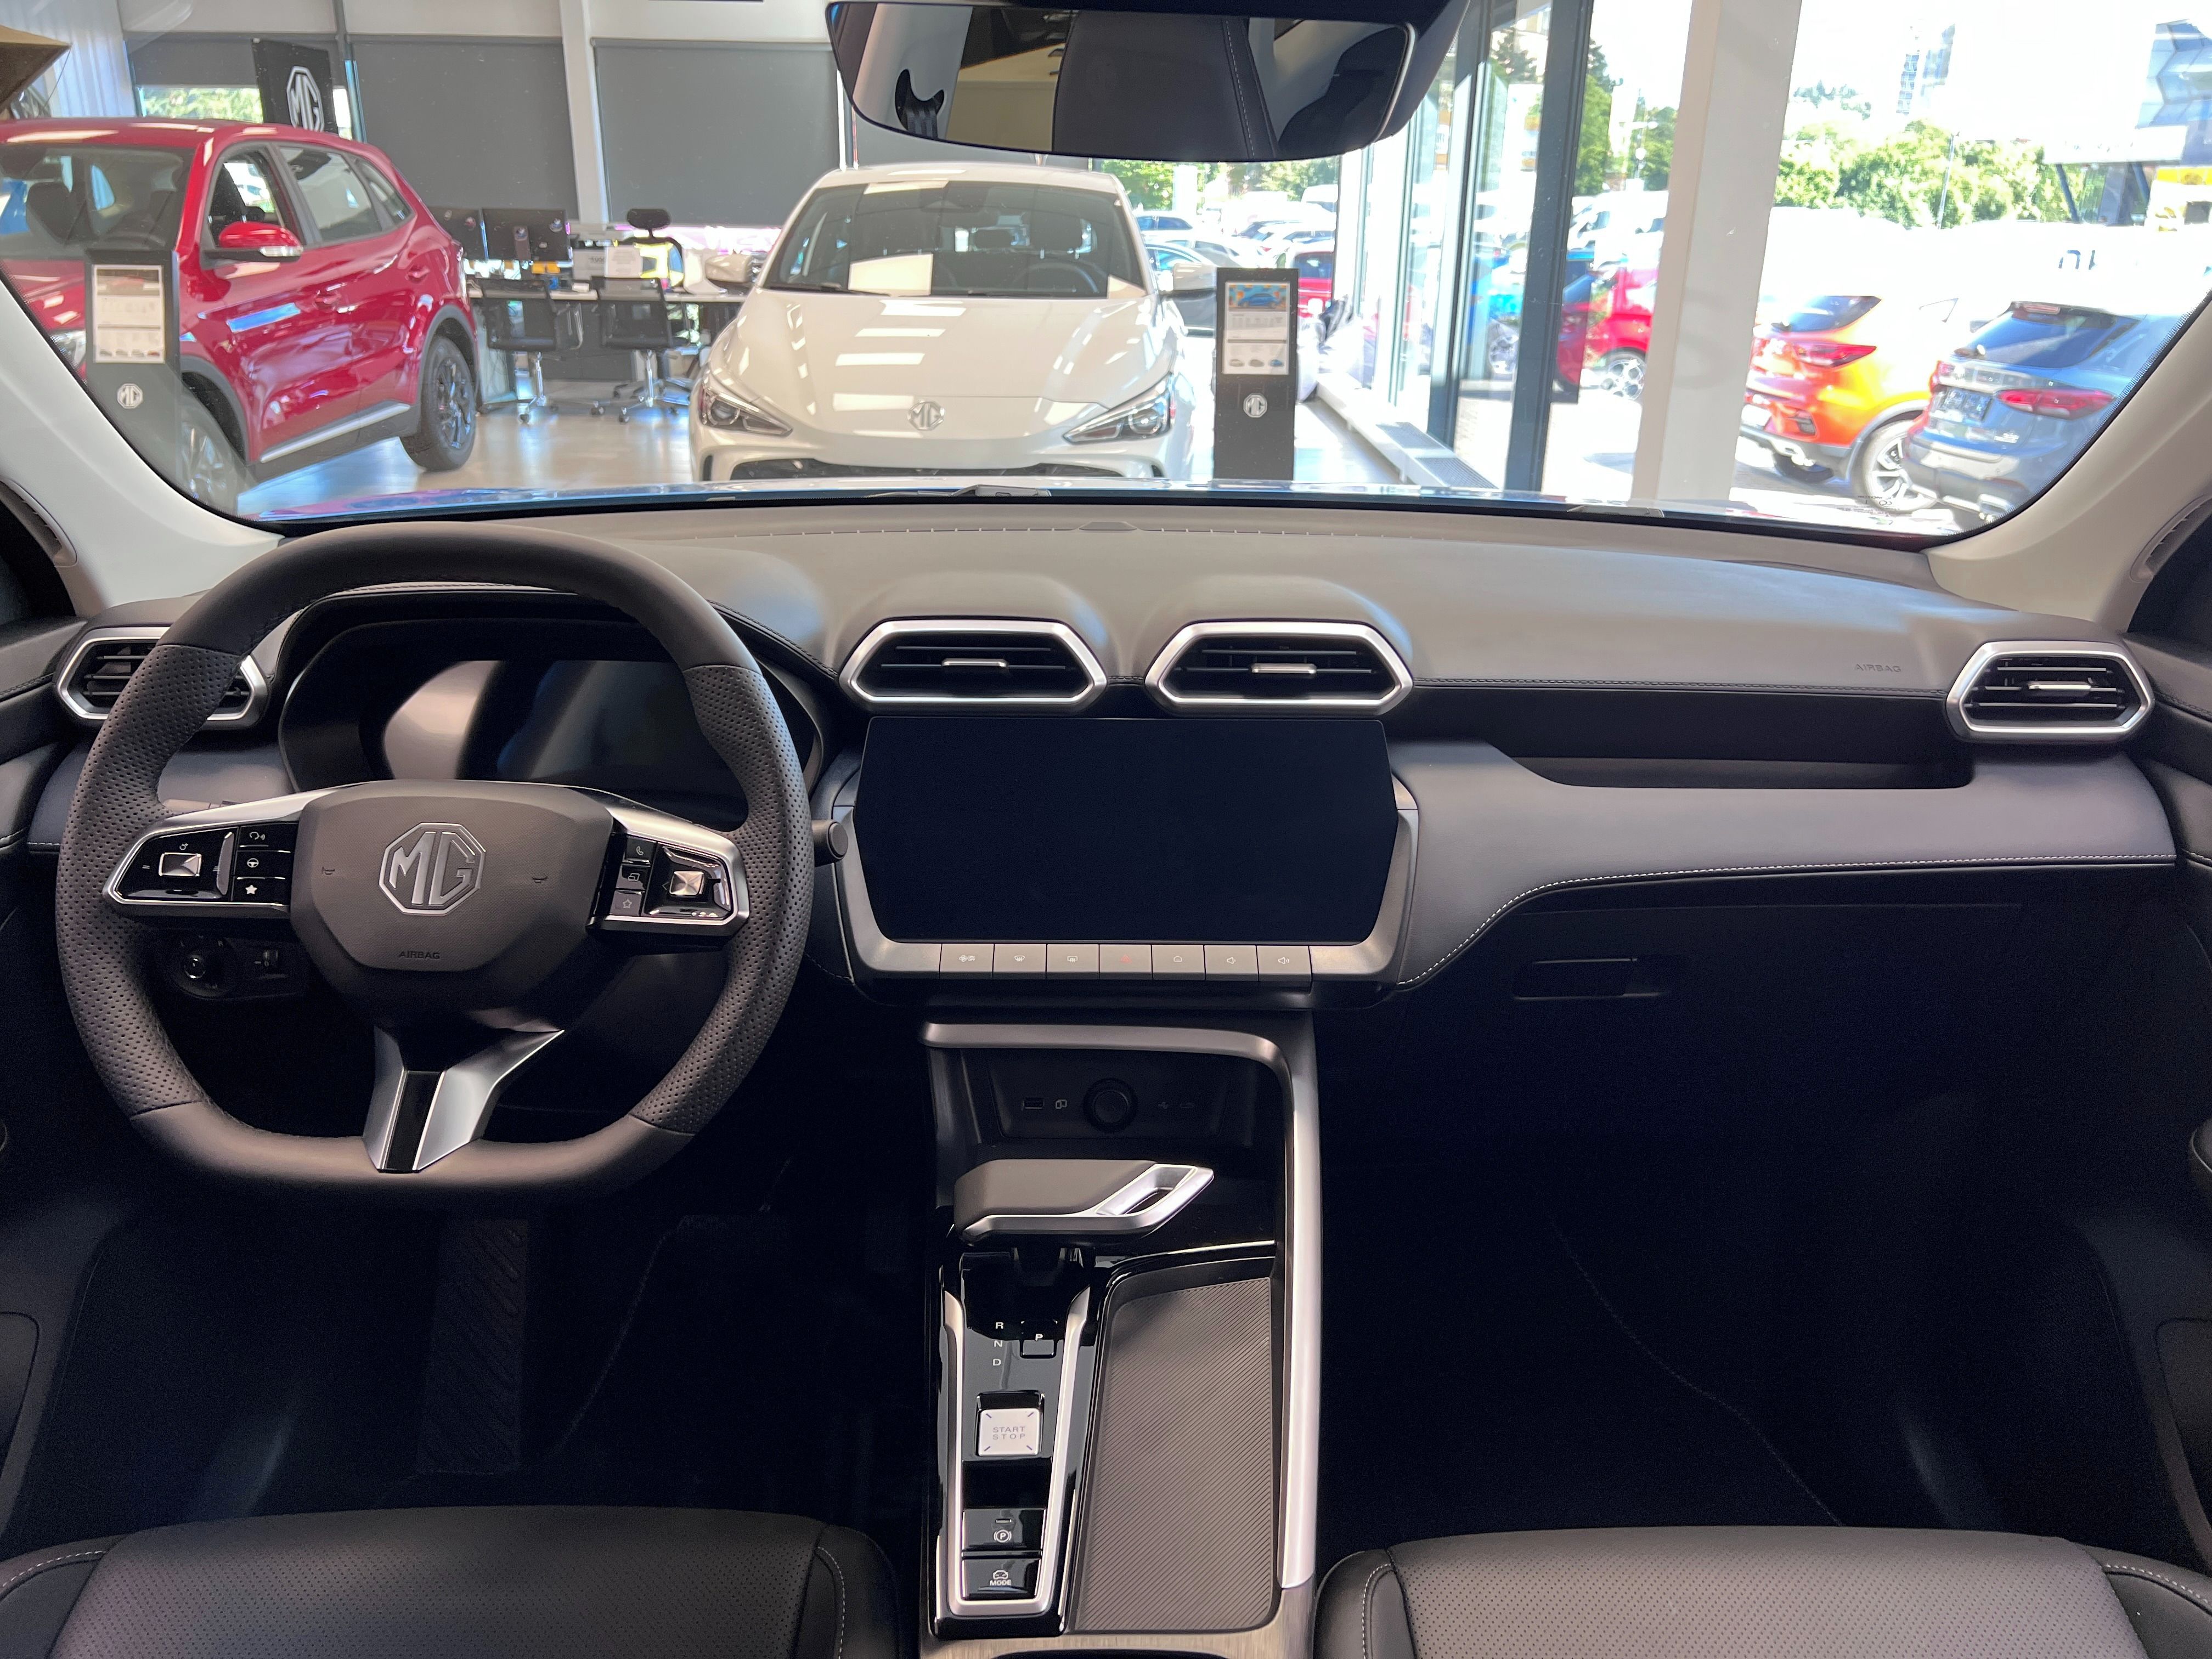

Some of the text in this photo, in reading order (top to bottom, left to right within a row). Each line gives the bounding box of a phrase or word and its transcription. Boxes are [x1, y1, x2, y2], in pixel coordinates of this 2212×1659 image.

[288, 69, 323, 132] MG
[910, 402, 942, 428] MG
[1855, 663, 1901, 673] AIRBAG
[385, 827, 478, 909] MG
[398, 950, 441, 960] AIRBAG
[992, 1358, 1002, 1366] D
